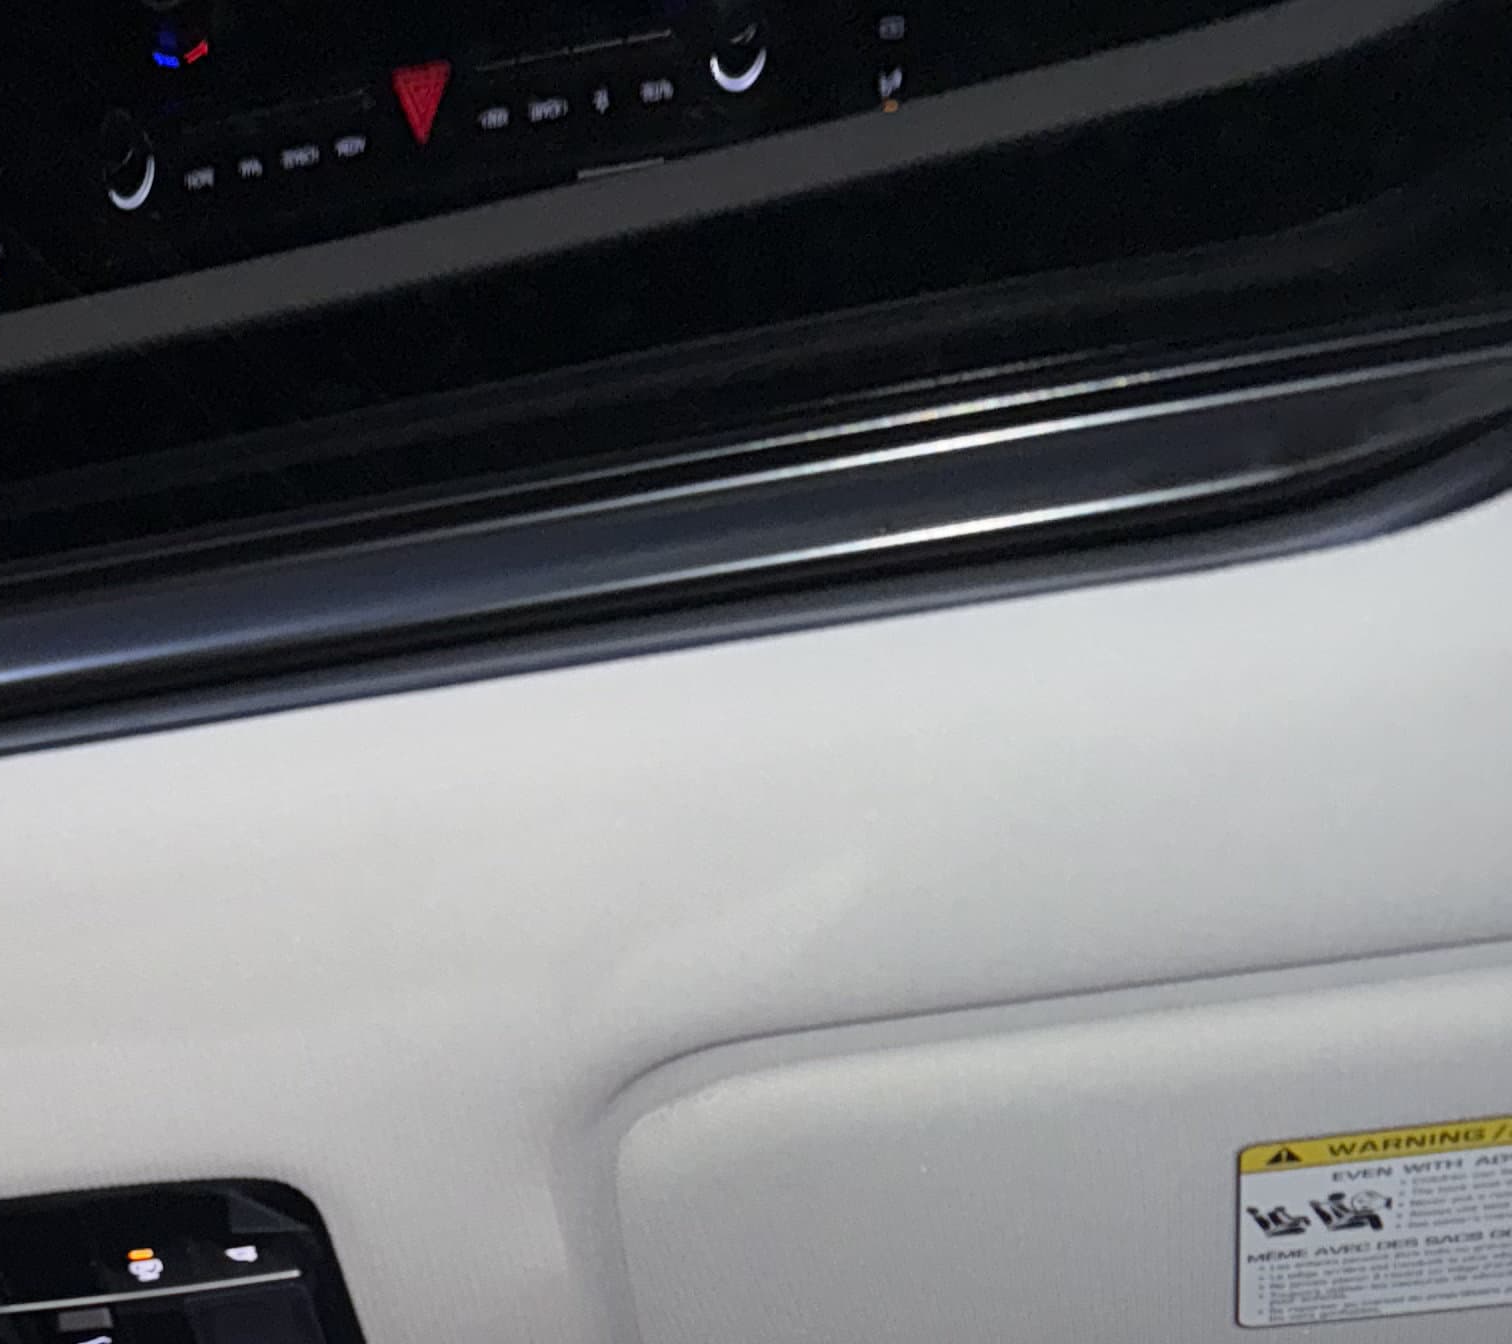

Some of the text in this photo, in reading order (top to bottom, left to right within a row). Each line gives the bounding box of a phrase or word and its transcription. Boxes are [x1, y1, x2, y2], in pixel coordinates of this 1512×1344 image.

[1328, 1129, 1486, 1156] WARNING
[1331, 1166, 1392, 1182] EVEN
[1404, 1158, 1463, 1175] WITH
